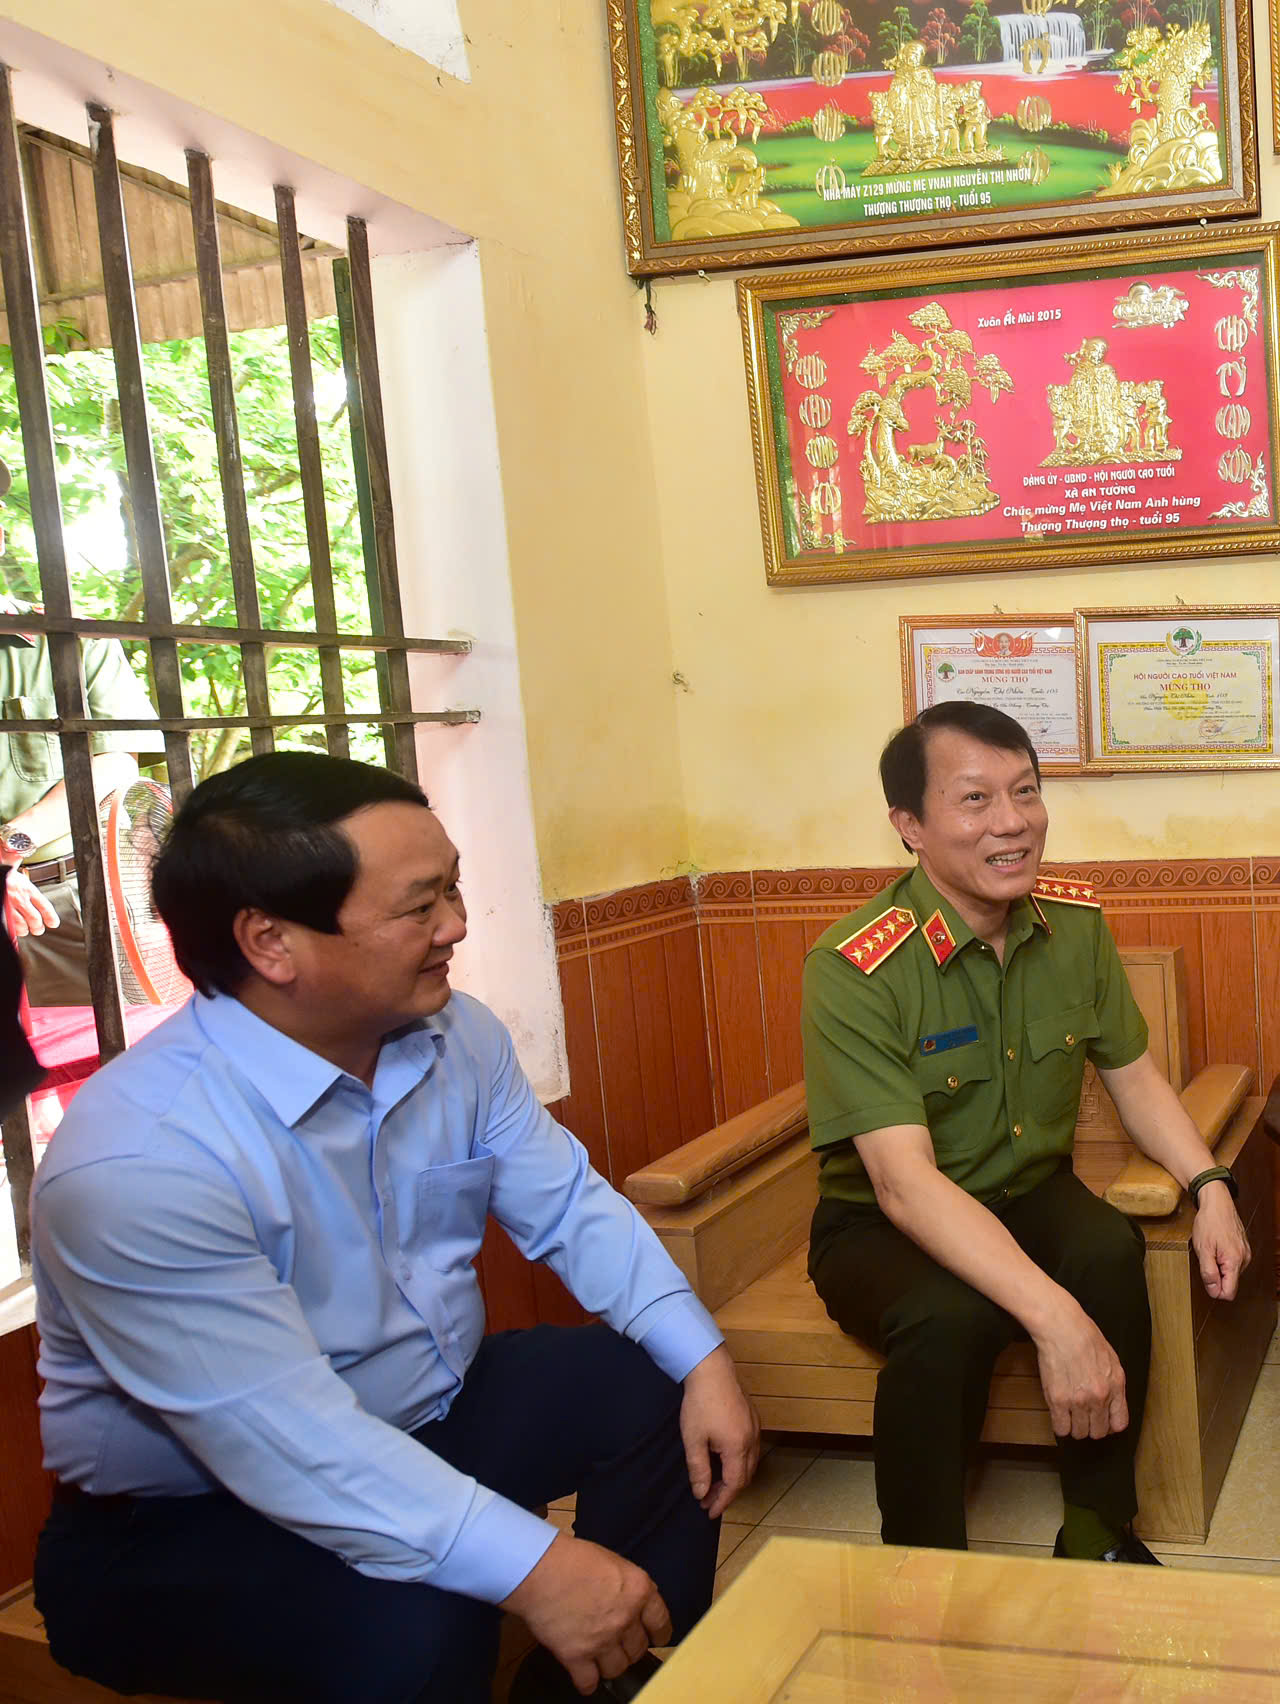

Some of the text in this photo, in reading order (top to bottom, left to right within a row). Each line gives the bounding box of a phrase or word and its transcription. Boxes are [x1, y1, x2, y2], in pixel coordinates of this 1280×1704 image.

[863, 183, 884, 197] Z129
[886, 179, 911, 194] MỪNG
[913, 179, 926, 192] MẸ
[929, 176, 952, 190] VNAH
[954, 168, 988, 188] NGUYỄN
[990, 170, 1004, 185] THỊ
[864, 202, 897, 218] THƯỢNG
[900, 198, 933, 214] THƯỢNG
[935, 196, 952, 210] THỌ
[959, 189, 978, 206] TUỔI
[980, 192, 991, 204] 95
[978, 308, 1062, 328] Xuân Ất Mùi 2015
[1023, 473, 1045, 487] ĐẢNG
[1064, 473, 1087, 484] UBND
[1094, 469, 1108, 483] HỘI
[1110, 467, 1136, 480] NGƯỜI
[1137, 468, 1154, 479] CAO
[1156, 463, 1175, 477] TUỔI
[1081, 487, 1096, 498] AN
[1099, 482, 1136, 496] TƯỜNG
[1003, 495, 1200, 517] Chúc mừng Mẹ Việt Nam Anh hùng
[1020, 521, 1062, 534] Thượng
[1065, 518, 1107, 532] Thượng
[1110, 516, 1129, 529] thọ
[1140, 511, 1163, 525] tuổi
[1165, 513, 1180, 524] 95
[1011, 676, 1028, 684] THỌ
[1134, 672, 1146, 681] HỘI
[1147, 671, 1170, 680] NGƯỜI
[1189, 670, 1205, 679] TUỔI
[1206, 671, 1220, 679] VIỆT
[1160, 682, 1211, 692] MỪNG THỌ
